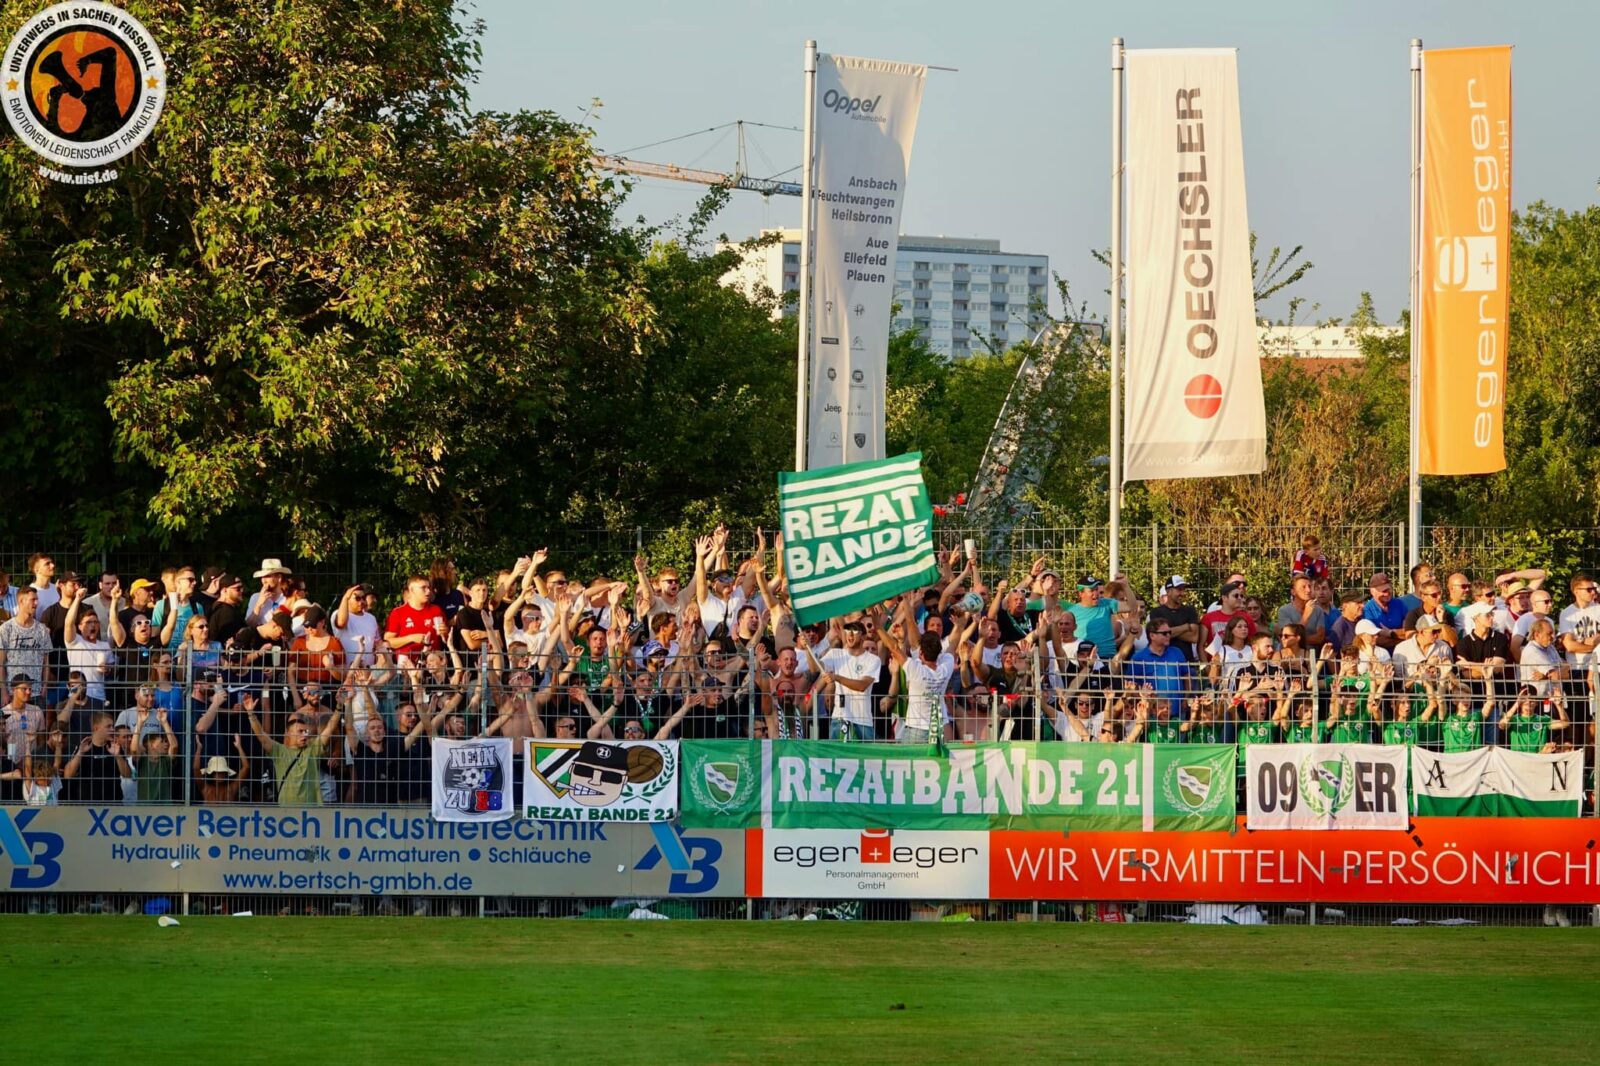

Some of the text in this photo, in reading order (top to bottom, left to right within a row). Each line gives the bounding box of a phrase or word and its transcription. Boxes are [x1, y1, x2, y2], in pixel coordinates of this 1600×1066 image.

[823, 89, 882, 115] Oppel
[851, 113, 887, 124] Automobile
[1468, 79, 1498, 233] eger
[848, 176, 898, 191] Ansbach
[818, 189, 895, 209] Feuchtwangen
[832, 208, 893, 225] Heilsbronn
[1176, 87, 1218, 359] OECHSLER
[866, 237, 889, 249] Aue
[844, 253, 887, 266] Ellefeld
[847, 269, 885, 283] Plauen
[1475, 295, 1498, 448] eger
[824, 403, 842, 414] Jeep
[784, 486, 920, 542] REZAT
[786, 519, 929, 579] BANDE
[449, 746, 497, 769] NEIN
[598, 748, 609, 758] 21
[778, 748, 1140, 815] REZATBANDE 21
[1258, 762, 1397, 814] 09 ER
[445, 788, 471, 809] ZU
[87, 808, 186, 837] Xaver
[197, 809, 321, 838] Bertsch
[527, 806, 675, 821] REZAT BANDE 21
[112, 844, 200, 863] Hydraulik
[358, 846, 460, 863] Armaturen
[488, 846, 592, 864] Schläuche
[1005, 842, 1600, 886] WIR VERMITTELN PERSÖNLICH
[224, 870, 472, 894] www.bertsch-gmbh.de
[825, 869, 919, 881] Personalmanagement
[857, 881, 886, 890] GmbH
